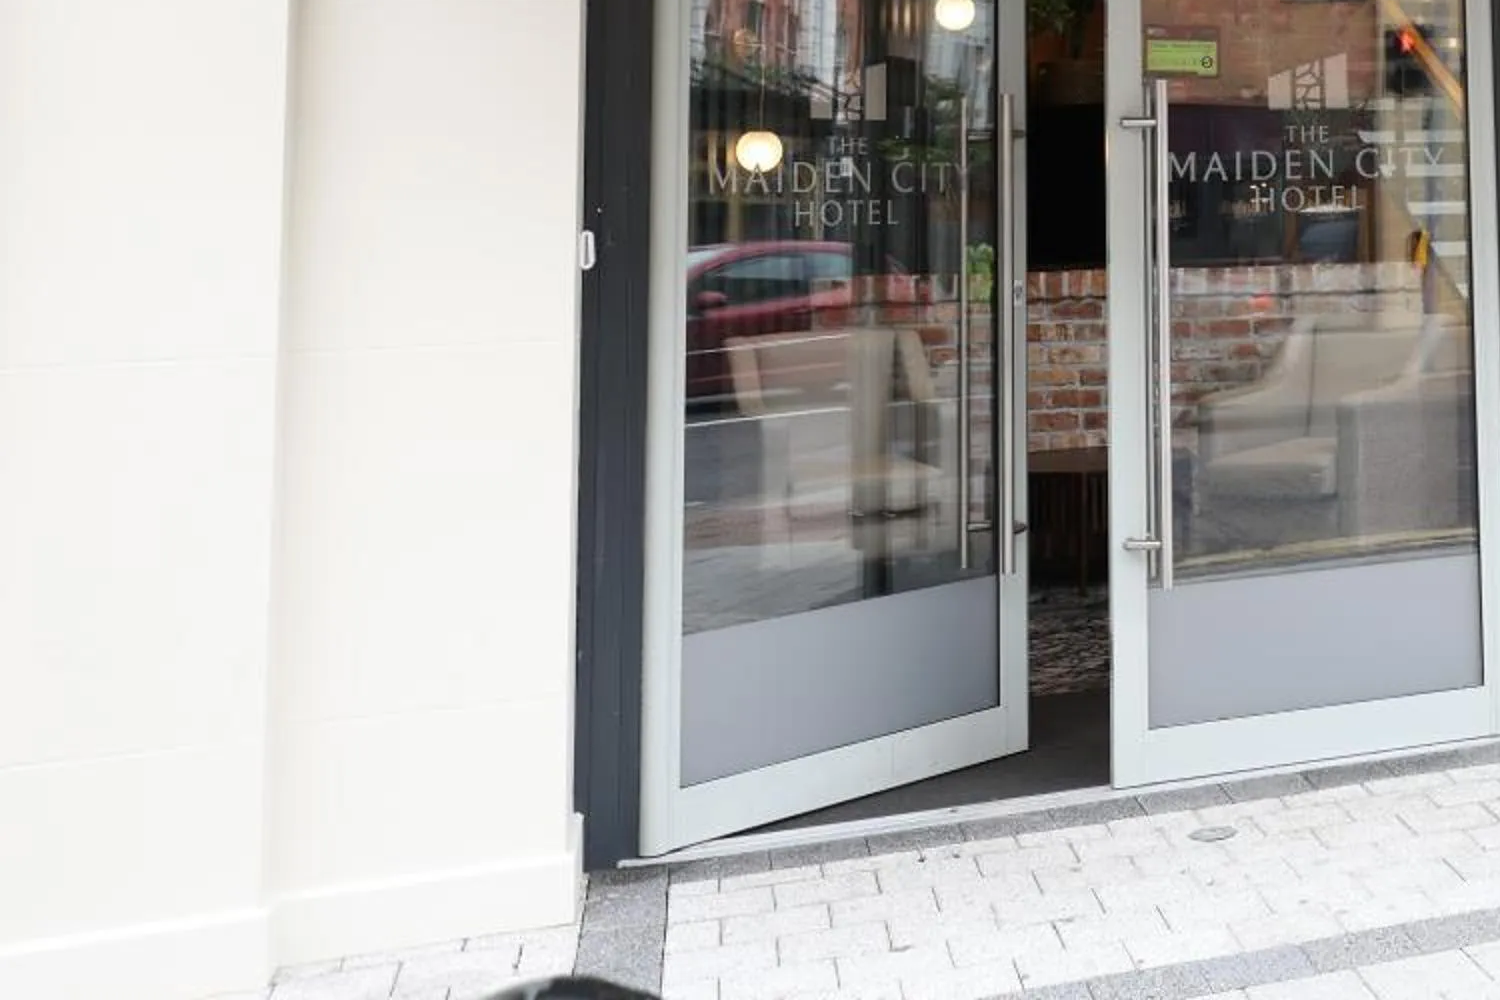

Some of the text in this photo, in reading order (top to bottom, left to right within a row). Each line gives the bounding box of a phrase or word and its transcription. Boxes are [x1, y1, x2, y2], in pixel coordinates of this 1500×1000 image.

[828, 136, 868, 156] THE
[1285, 125, 1329, 144] THE
[708, 161, 872, 195] MAIDEN
[1168, 147, 1445, 182] MAIDEN CITY
[1252, 184, 1364, 212] HOTEL
[794, 198, 899, 227] HOTEL
